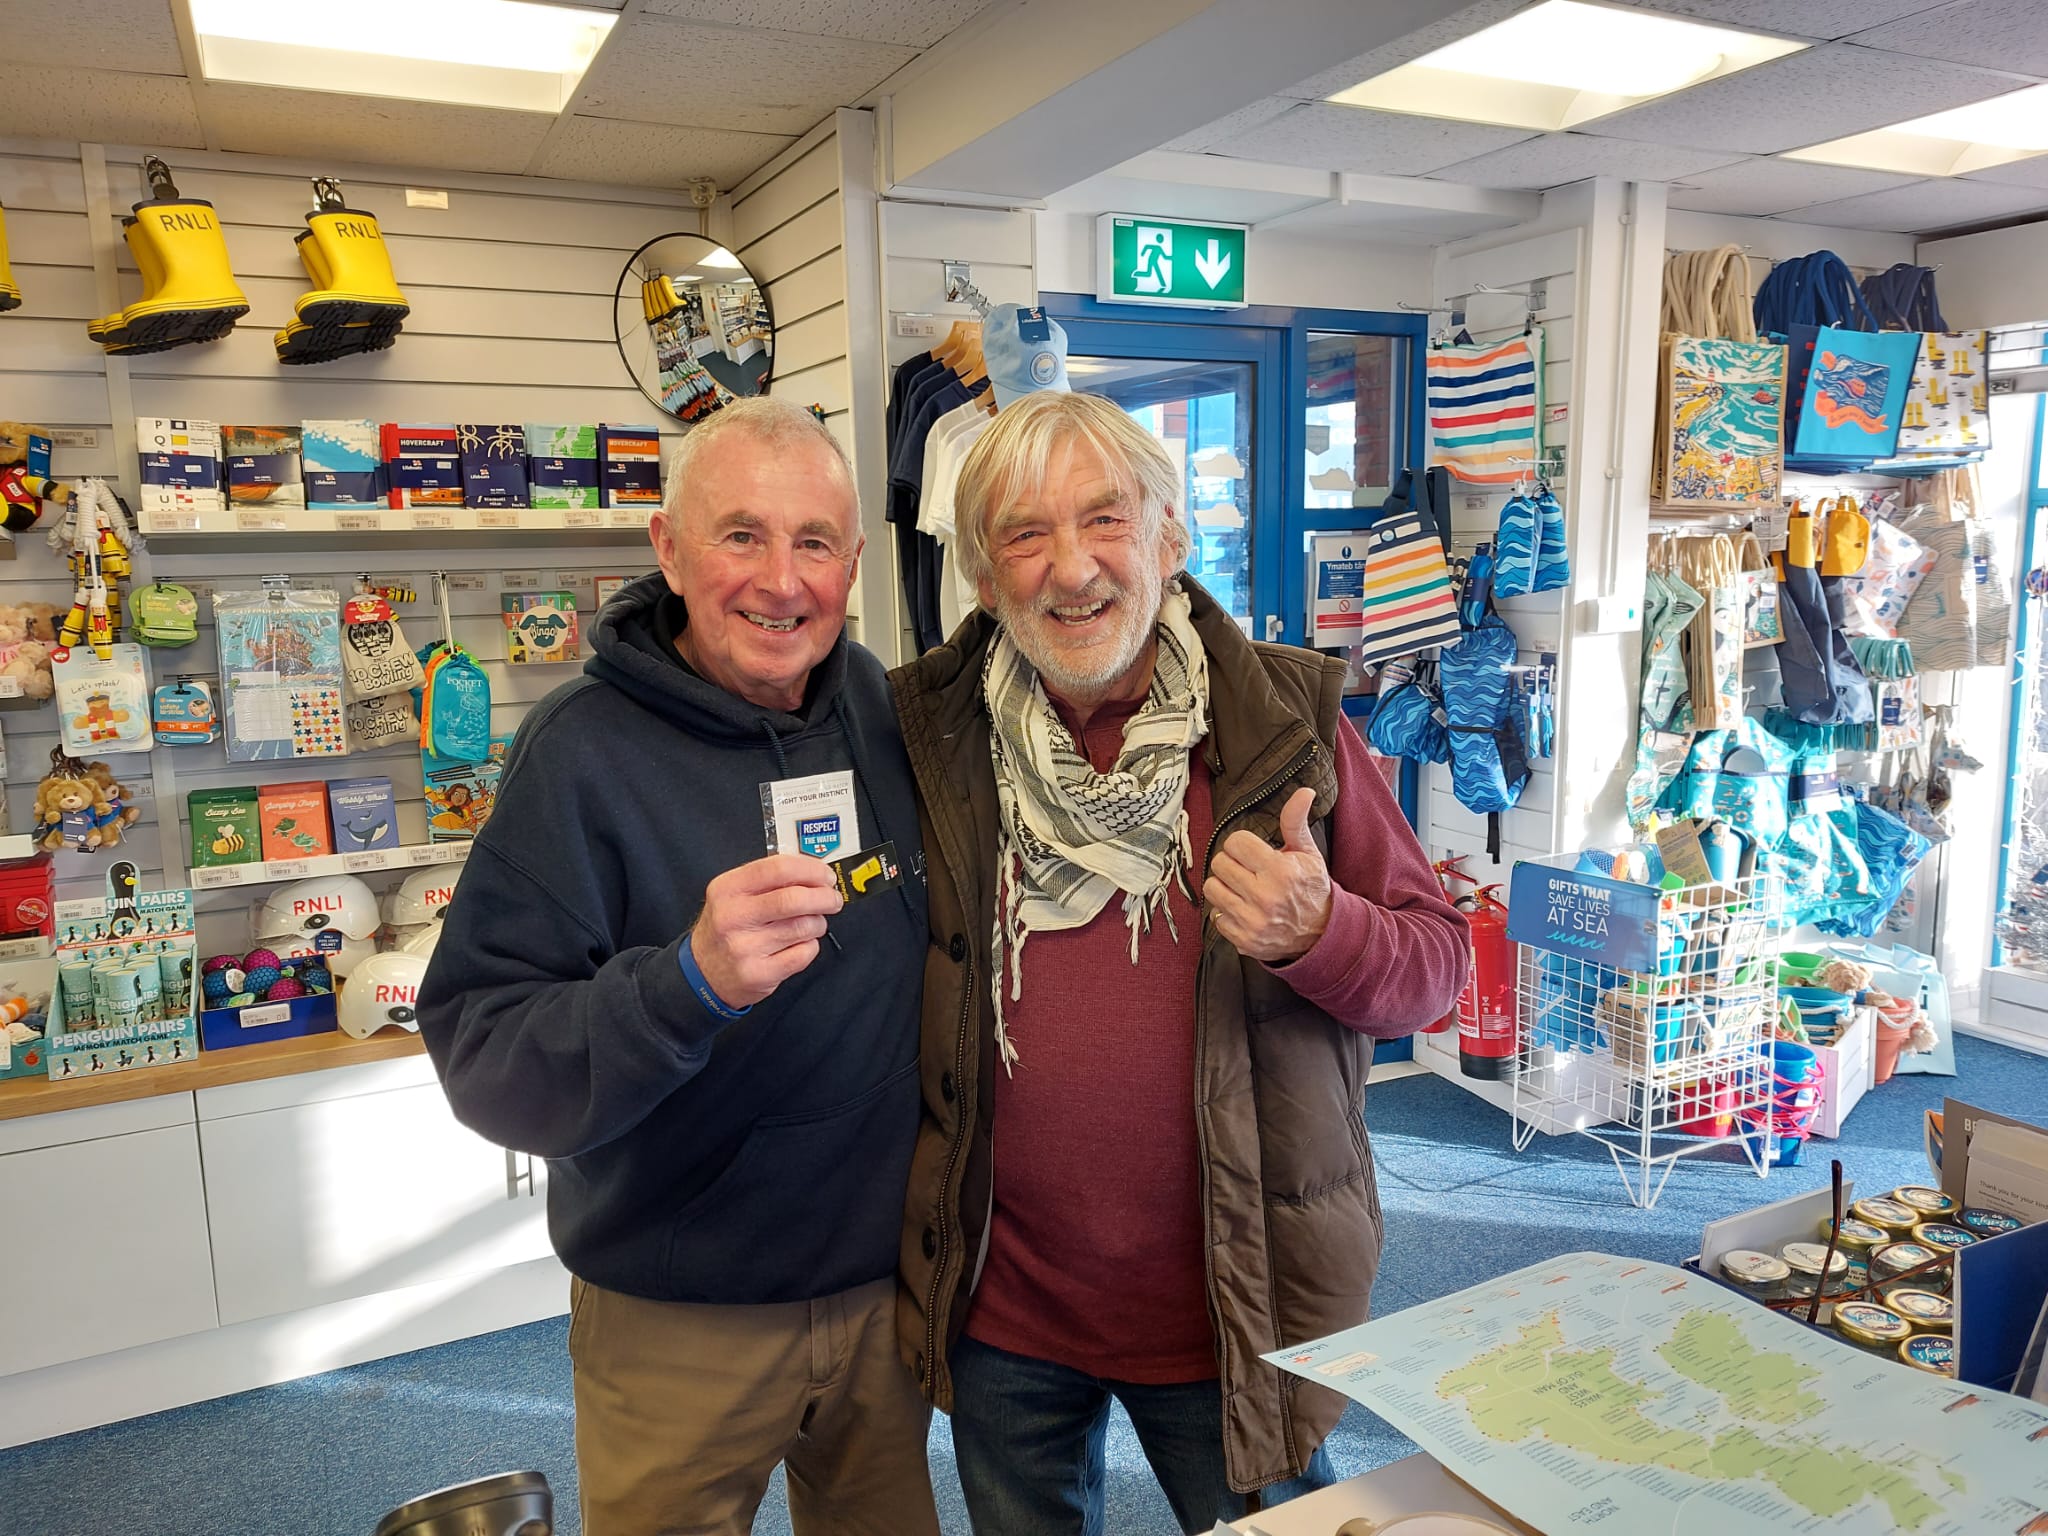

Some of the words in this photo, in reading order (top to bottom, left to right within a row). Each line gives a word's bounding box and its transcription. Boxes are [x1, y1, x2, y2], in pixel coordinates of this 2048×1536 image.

[159, 212, 213, 232] RNLI
[335, 221, 381, 241] RNLI
[155, 420, 162, 429] P
[154, 435, 166, 447] Q
[400, 439, 445, 447] HOVERCRAFT
[160, 495, 169, 503] U
[1327, 562, 1353, 571] Ymateb
[348, 668, 368, 683] 10
[368, 652, 415, 679] CREW
[363, 665, 414, 690] Bowling
[447, 676, 483, 688] POCKET
[348, 718, 365, 733] 10
[364, 704, 408, 730] CREW
[361, 719, 407, 740] Bowling
[779, 796, 798, 806] IGHT
[799, 793, 818, 802] YOUR
[818, 788, 849, 799] INSTINCT
[803, 820, 838, 834] RESPECT
[804, 837, 816, 845] THE
[816, 834, 838, 844] WATER
[141, 891, 186, 909] PAIRS
[424, 887, 454, 906] RN
[1548, 878, 1580, 896] GIFTS
[1581, 885, 1612, 903] THAT
[165, 904, 187, 912] GAME
[293, 895, 343, 917] RNLI
[1548, 892, 1576, 910] SAVE
[1577, 898, 1611, 916] LIVES
[1547, 907, 1569, 927] AT
[1572, 913, 1610, 937] SEA
[375, 984, 417, 1003] RNL
[52, 1026, 134, 1049] PENGUIN
[137, 1019, 187, 1037] PAIRS
[73, 1041, 110, 1052] MEMORY
[112, 1037, 142, 1047] MATCH
[142, 1033, 169, 1042] GAME
[1972, 1214, 2017, 1230] Betty's
[1279, 1343, 1329, 1360] Lifeboats
